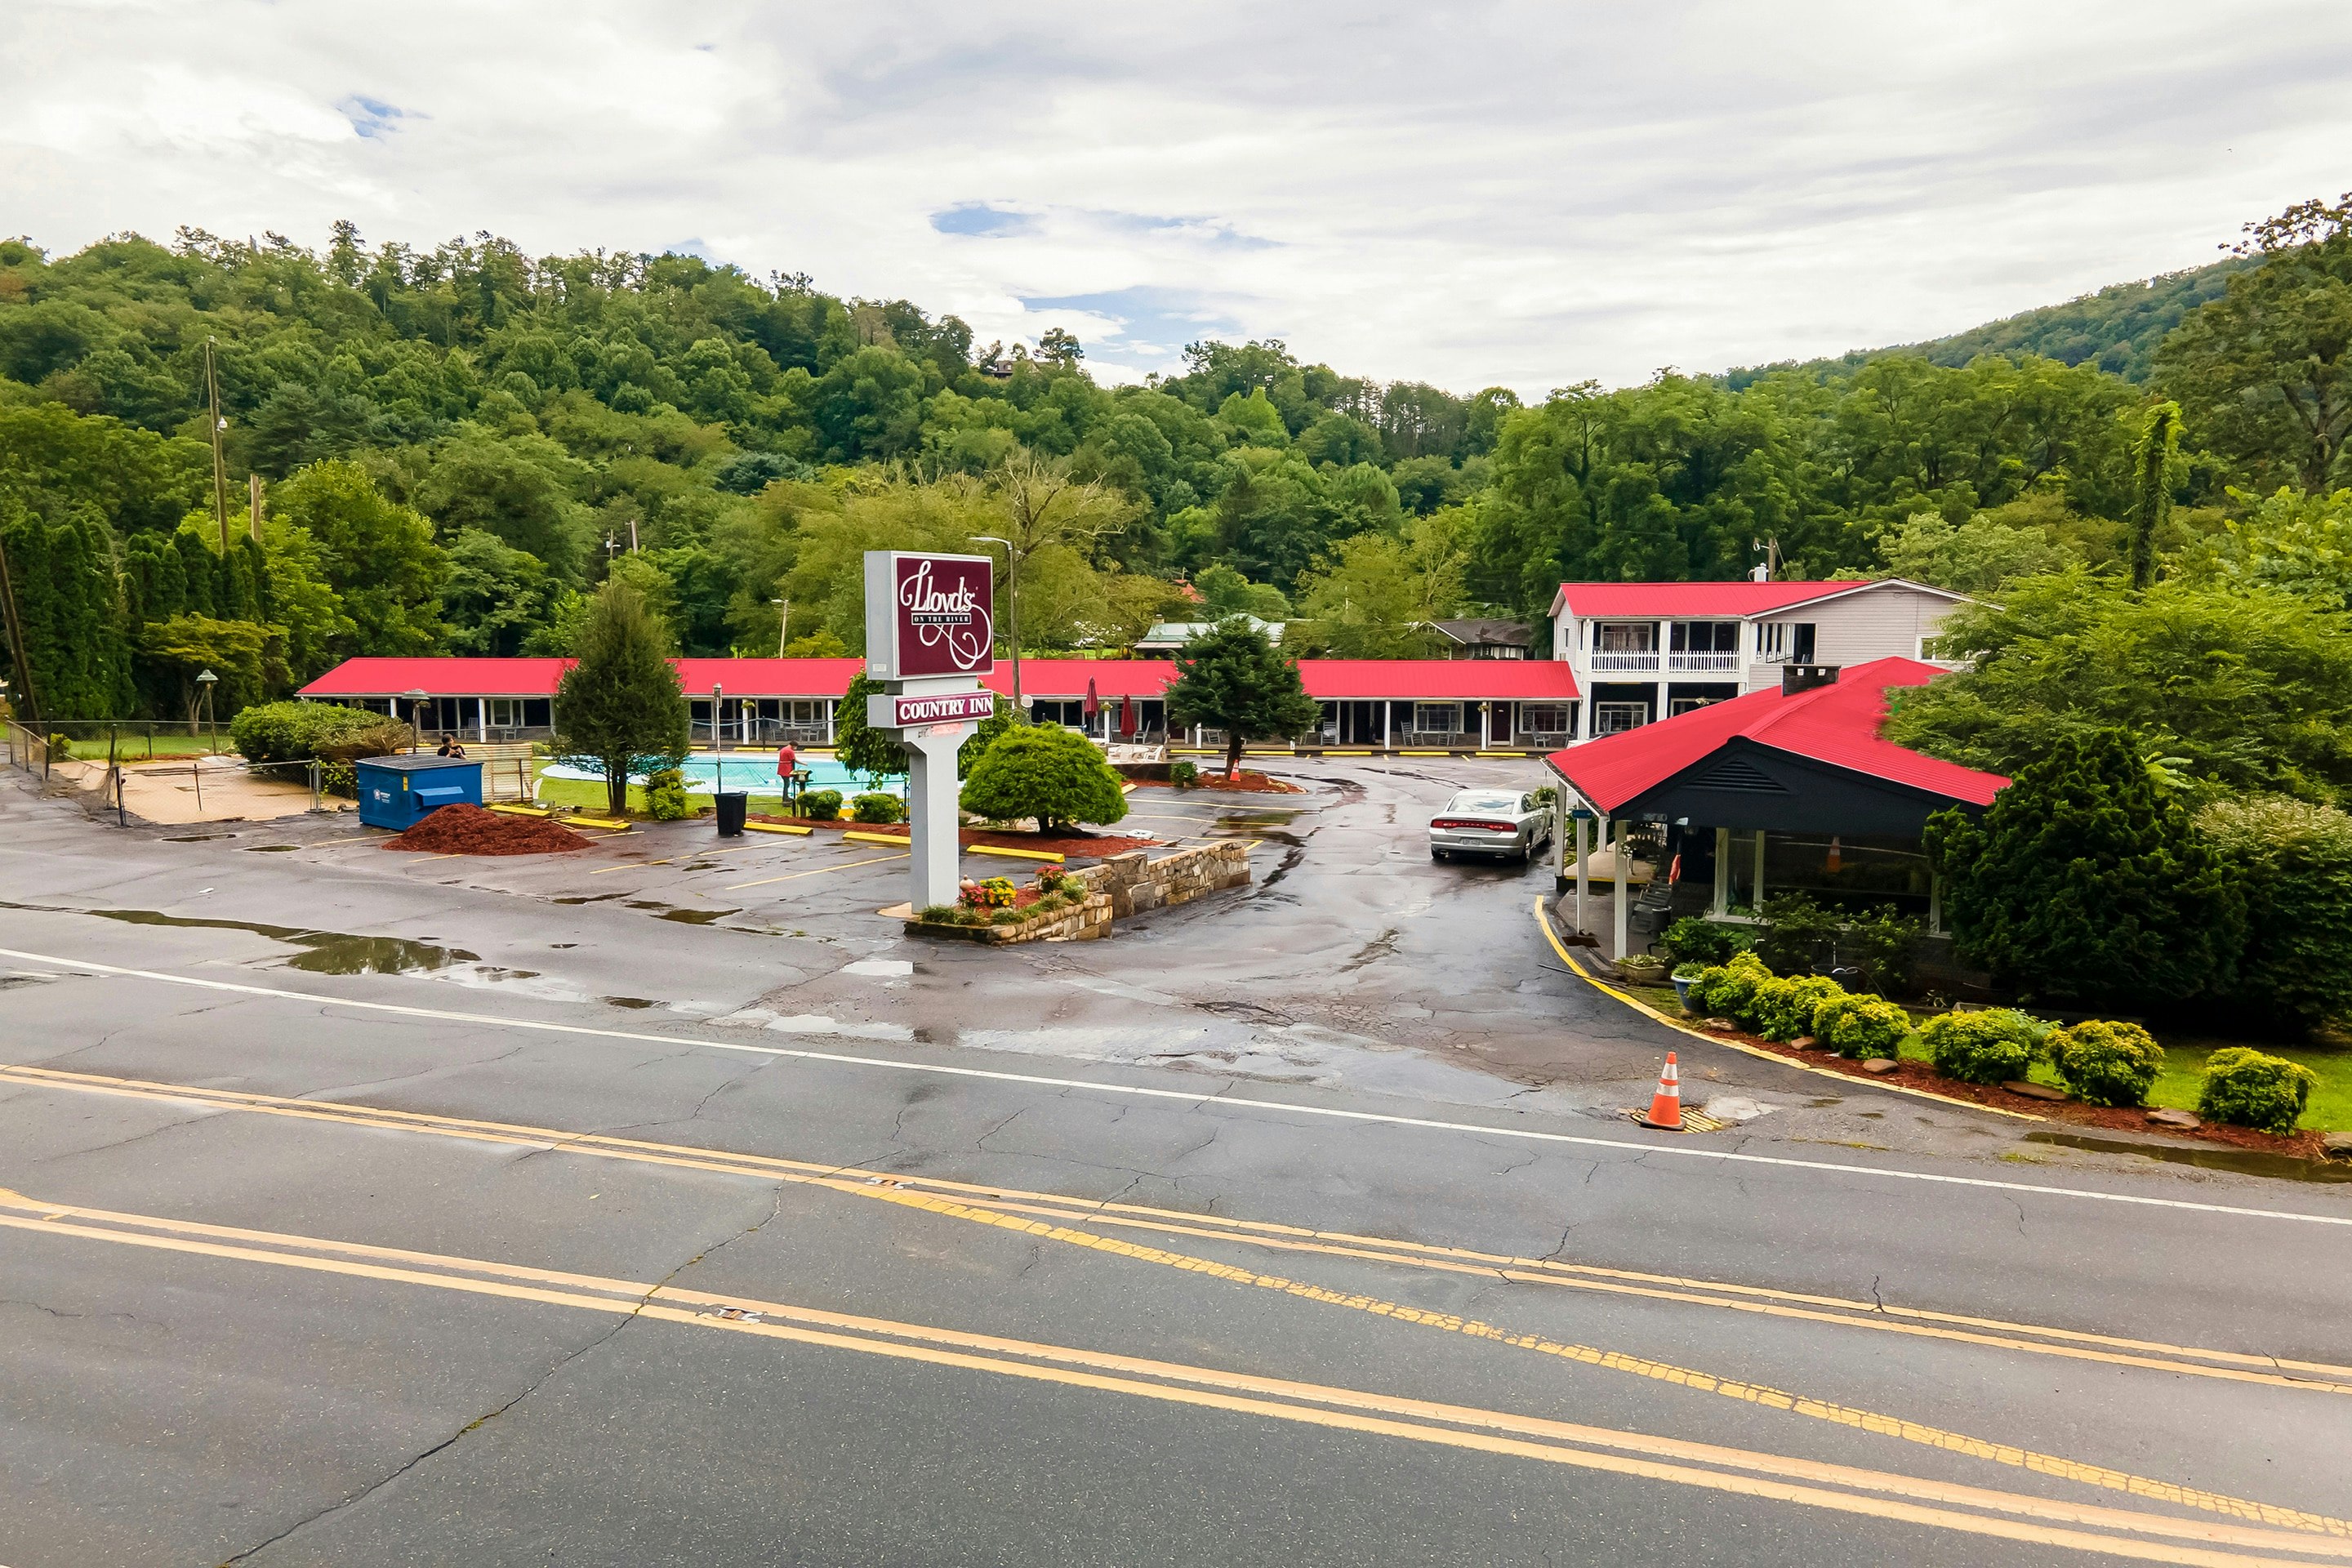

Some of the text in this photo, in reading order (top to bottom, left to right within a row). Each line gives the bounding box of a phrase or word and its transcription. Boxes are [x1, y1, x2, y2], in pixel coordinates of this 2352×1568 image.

[900, 560, 976, 614] Lloyd's
[899, 697, 992, 720] COUNTRY INN
